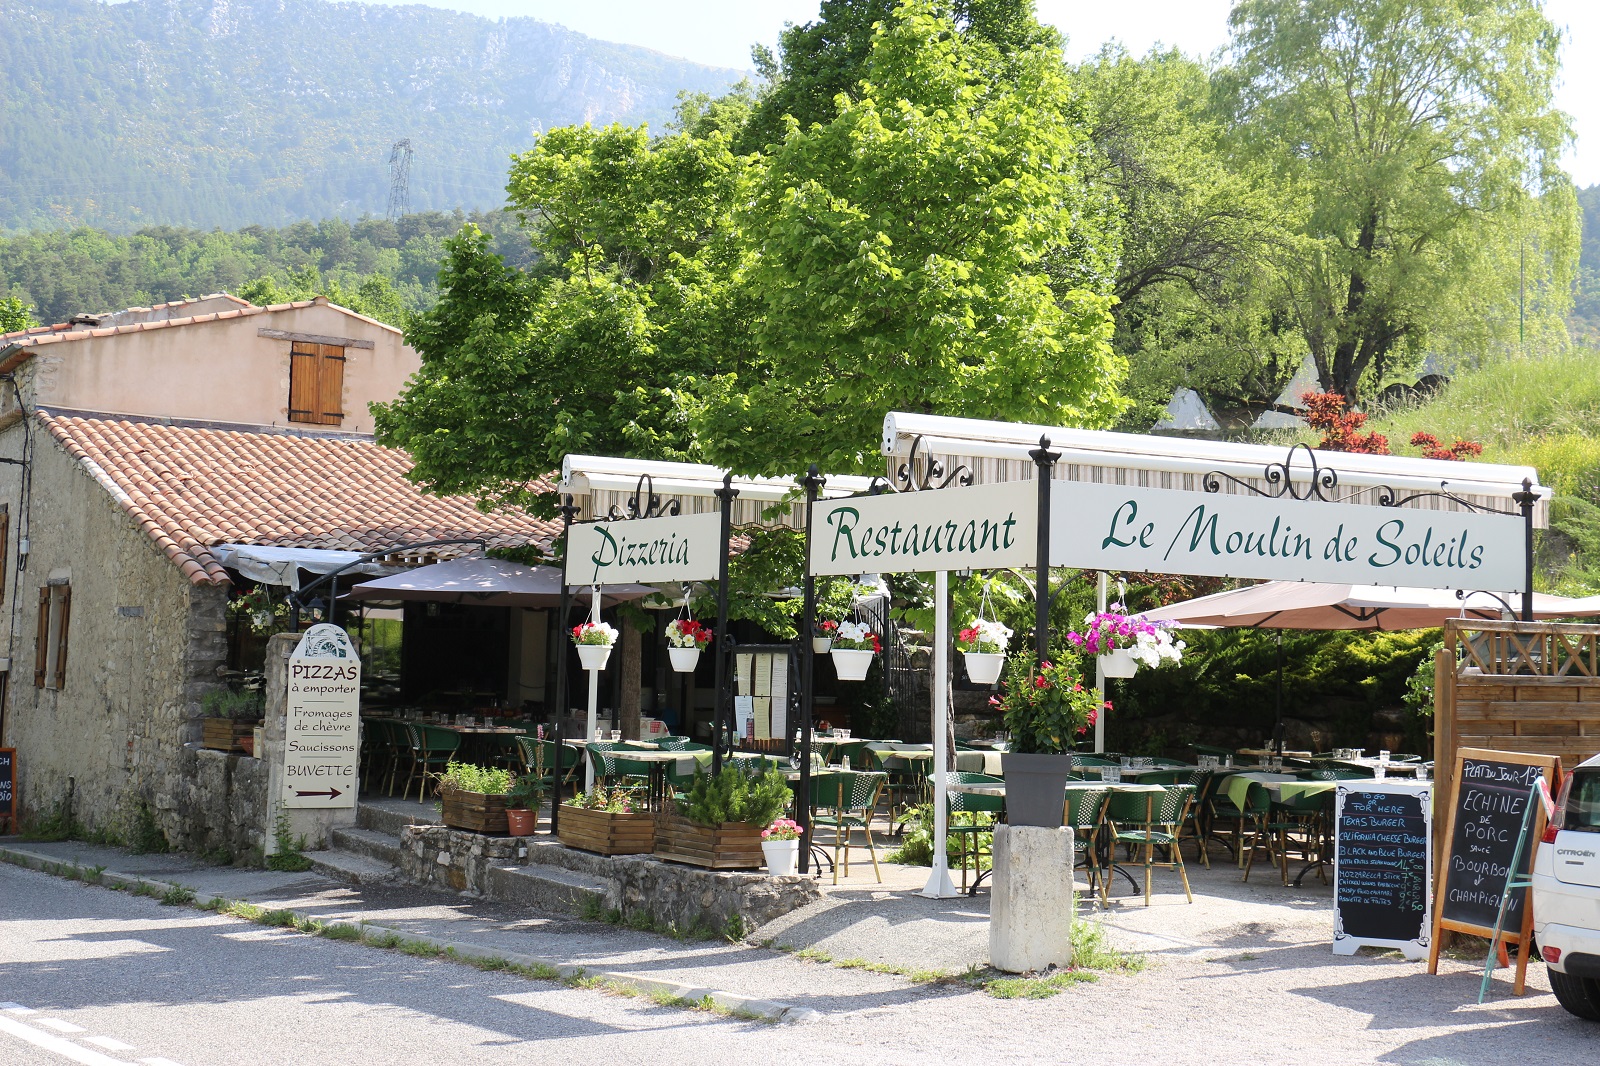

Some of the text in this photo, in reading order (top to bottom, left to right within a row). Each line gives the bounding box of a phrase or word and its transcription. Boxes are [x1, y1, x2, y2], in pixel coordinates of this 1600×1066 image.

[826, 506, 1017, 563] Restaurant
[1101, 499, 1485, 570] Le Moulin de Soleils
[591, 525, 690, 583] Pizzeria
[292, 664, 357, 681] PIZZAS
[291, 682, 356, 697] à emporter
[293, 706, 353, 722] Fromages
[294, 719, 351, 731] de chèvre
[288, 740, 355, 752] Saucissons
[287, 764, 354, 776] BUVETTE
[1463, 760, 1490, 778] PLAT
[1494, 766, 1520, 784] JOUR
[1377, 806, 1405, 814] HERE
[1341, 815, 1406, 828] TEXAS BURGER
[1479, 815, 1492, 825] DE
[1464, 822, 1508, 842] PORC
[1339, 846, 1367, 856] BLACK
[1378, 848, 1396, 857] BLUE
[1397, 847, 1426, 860] BURGER
